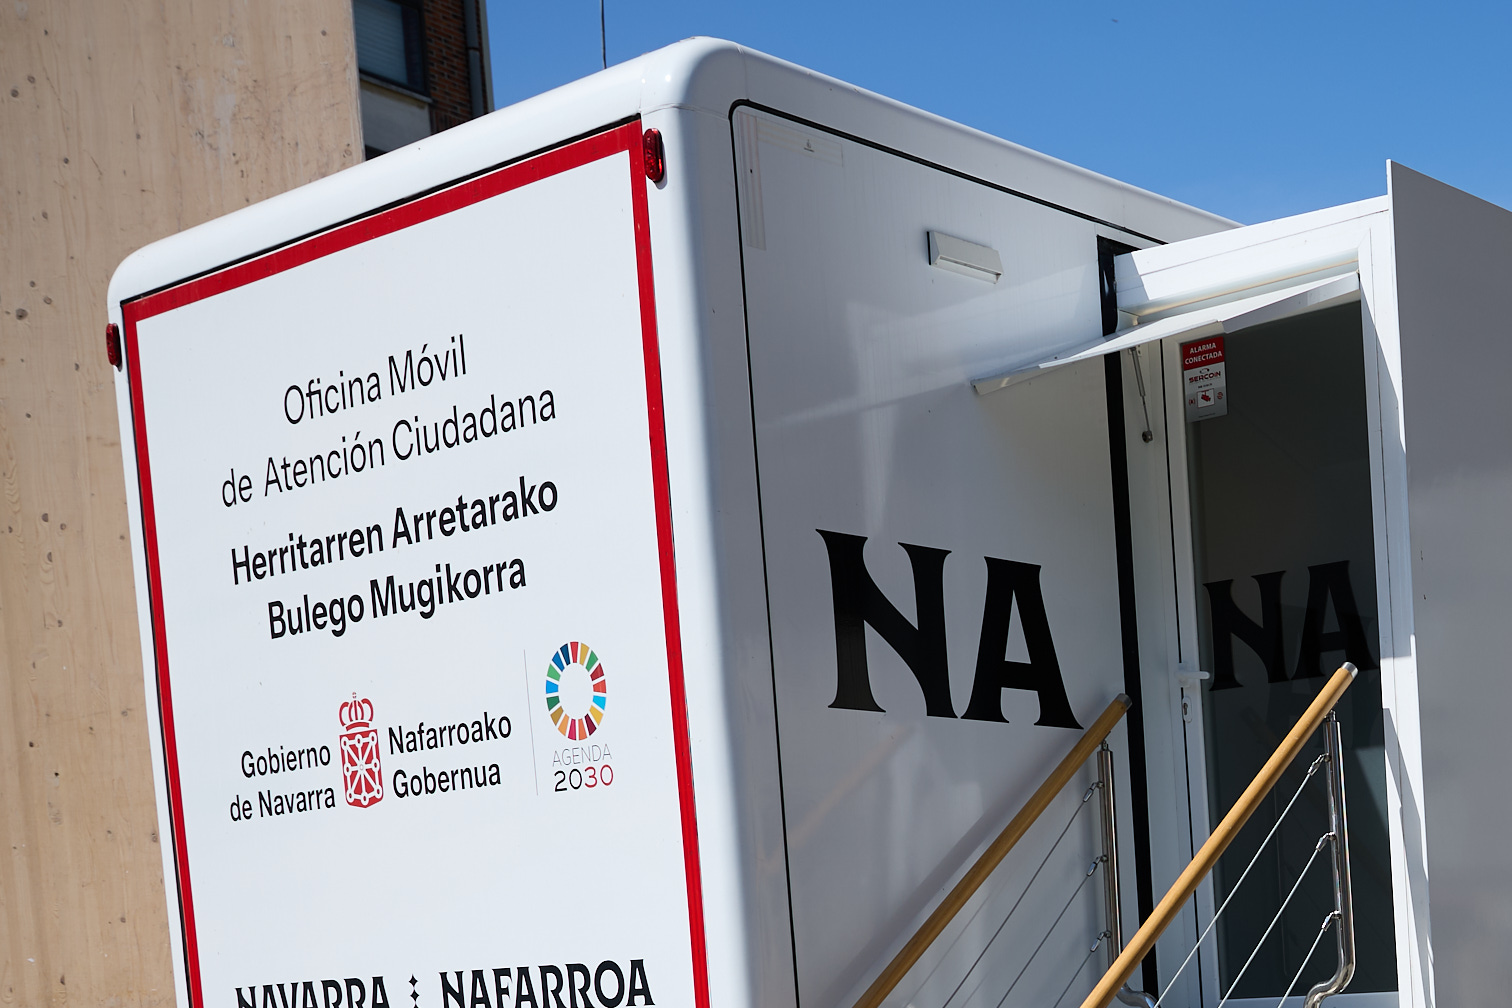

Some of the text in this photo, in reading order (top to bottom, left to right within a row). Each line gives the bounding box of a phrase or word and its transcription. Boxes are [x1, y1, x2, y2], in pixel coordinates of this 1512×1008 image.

[1185, 351, 1222, 364] CONECTADA
[1190, 343, 1216, 354] ALARMA
[283, 333, 467, 426] Oficina Móvil
[221, 388, 557, 509] de Atención Ciudadana
[230, 475, 559, 586] Herritarren Arretarako
[267, 557, 527, 640] Bulego Mugikorra
[815, 528, 1084, 729] NA
[1203, 560, 1379, 692] NA
[387, 711, 513, 756] Nafarroako
[240, 744, 332, 779] Gobierno
[551, 742, 613, 768] AGENDA
[391, 762, 502, 800] Gobernua
[553, 762, 615, 794] 2030
[229, 786, 336, 823] de Navarra
